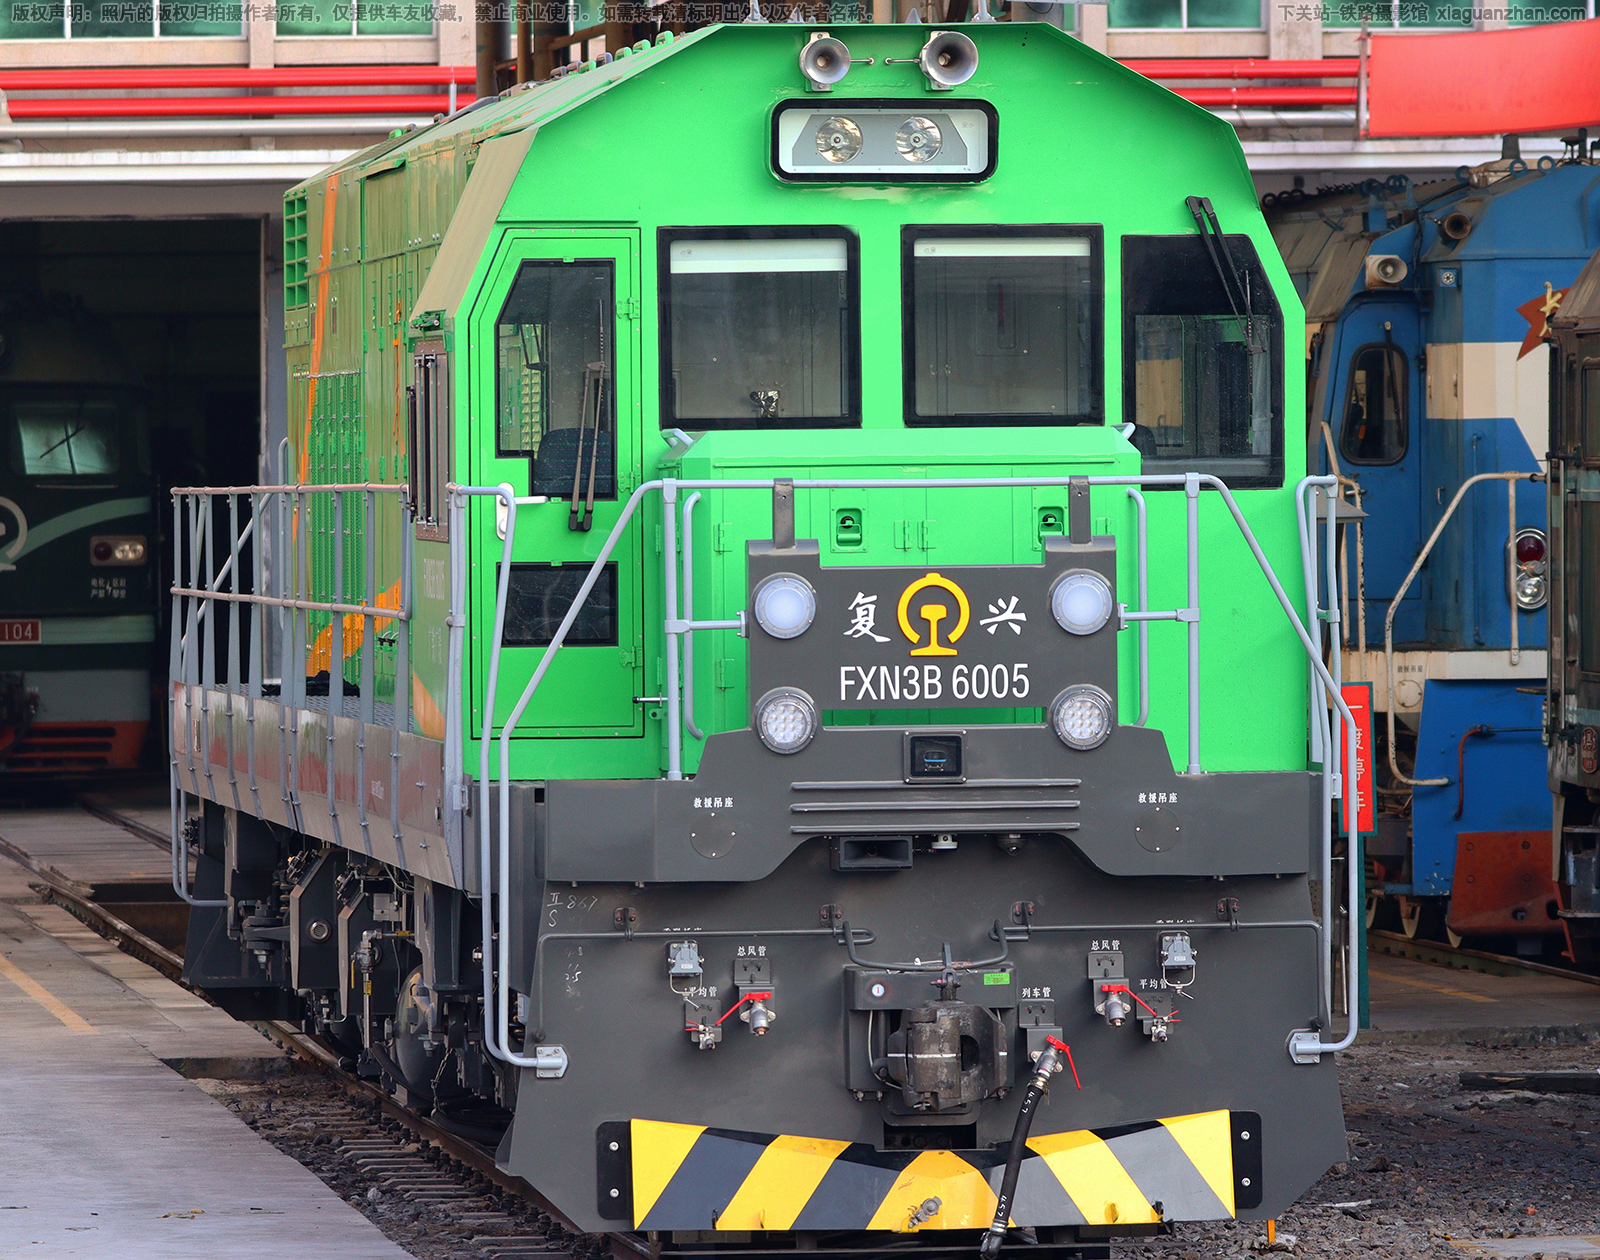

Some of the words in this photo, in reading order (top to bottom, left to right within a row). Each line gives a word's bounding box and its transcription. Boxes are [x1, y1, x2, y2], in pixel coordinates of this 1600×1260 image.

[843, 591, 891, 643] 复
[979, 595, 1027, 635] 兴
[840, 665, 942, 700] FXN3B
[952, 663, 1030, 698] 6005
[1091, 940, 1120, 950] 总风管
[737, 946, 767, 956] 总风管
[1022, 987, 1051, 998] 列车管
